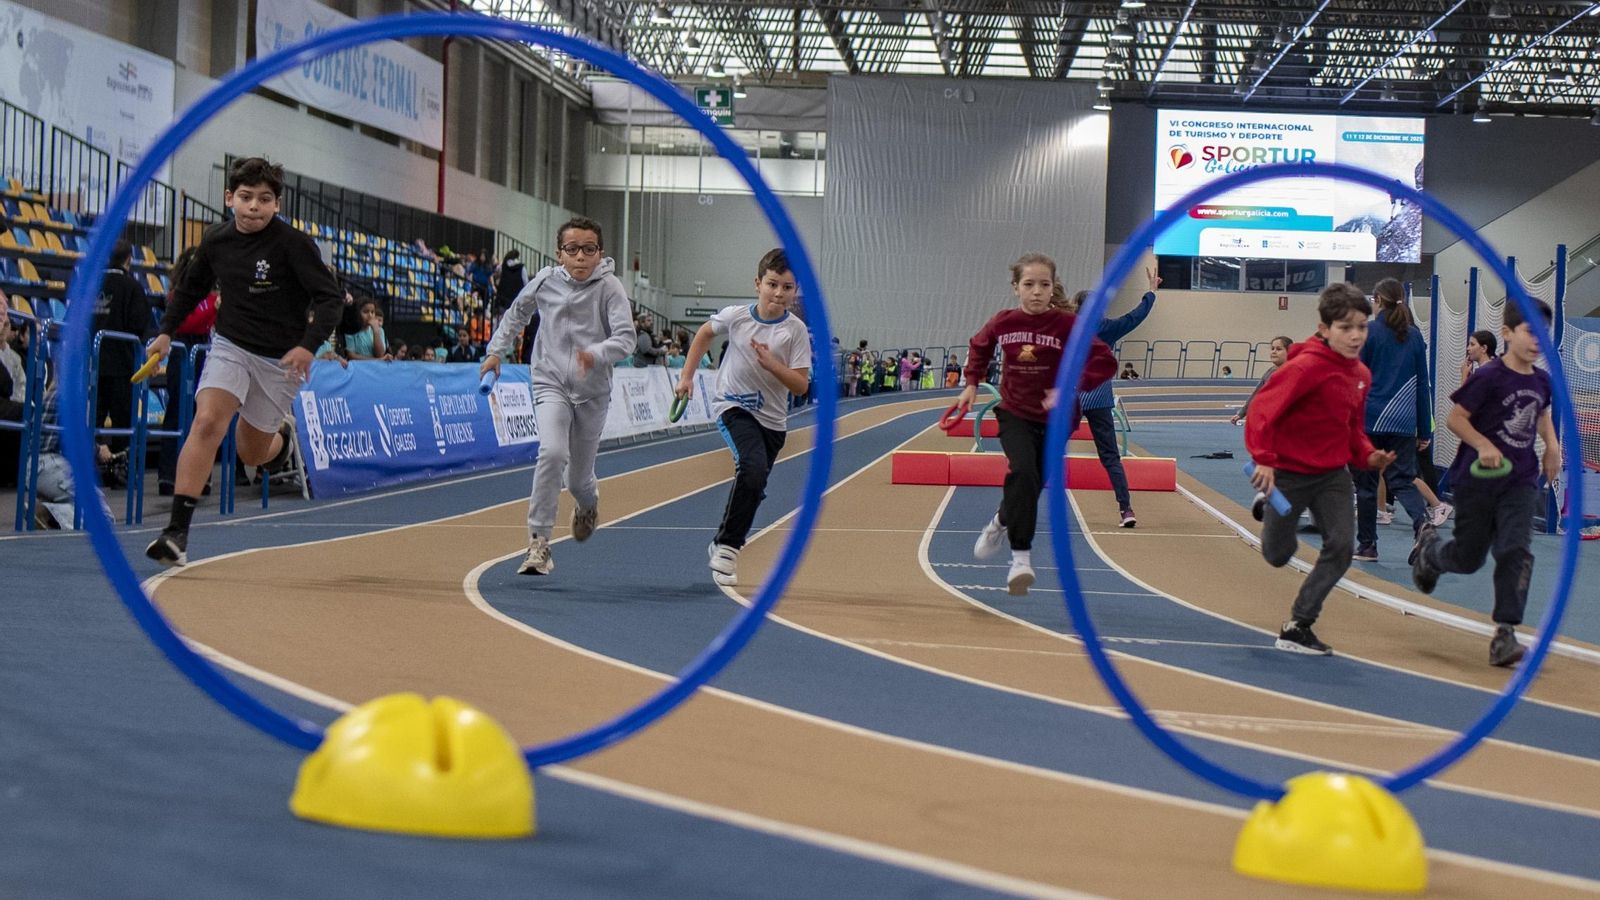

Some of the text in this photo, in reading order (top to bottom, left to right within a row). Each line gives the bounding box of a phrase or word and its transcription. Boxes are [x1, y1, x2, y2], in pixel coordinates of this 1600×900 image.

[372, 53, 418, 120] TERMAL
[699, 108, 732, 117] OTIQUÍN
[1181, 120, 1234, 129] CONGRESO
[1236, 122, 1314, 132] INTERNACIONAL
[1185, 130, 1227, 139] TURISMO
[1238, 132, 1283, 141] DEPORTE
[1202, 145, 1316, 165] SPORTUR
[1197, 208, 1289, 218] www.sporturgalicia.com
[998, 331, 1062, 350] ARIZONA STYLE
[318, 396, 353, 426] XUNTA
[388, 406, 414, 426] DEPORTE
[445, 421, 476, 446] OURENSE
[507, 414, 538, 439] OURENSE
[326, 430, 377, 461] DE GALICIA
[393, 432, 417, 453] GALEGO
